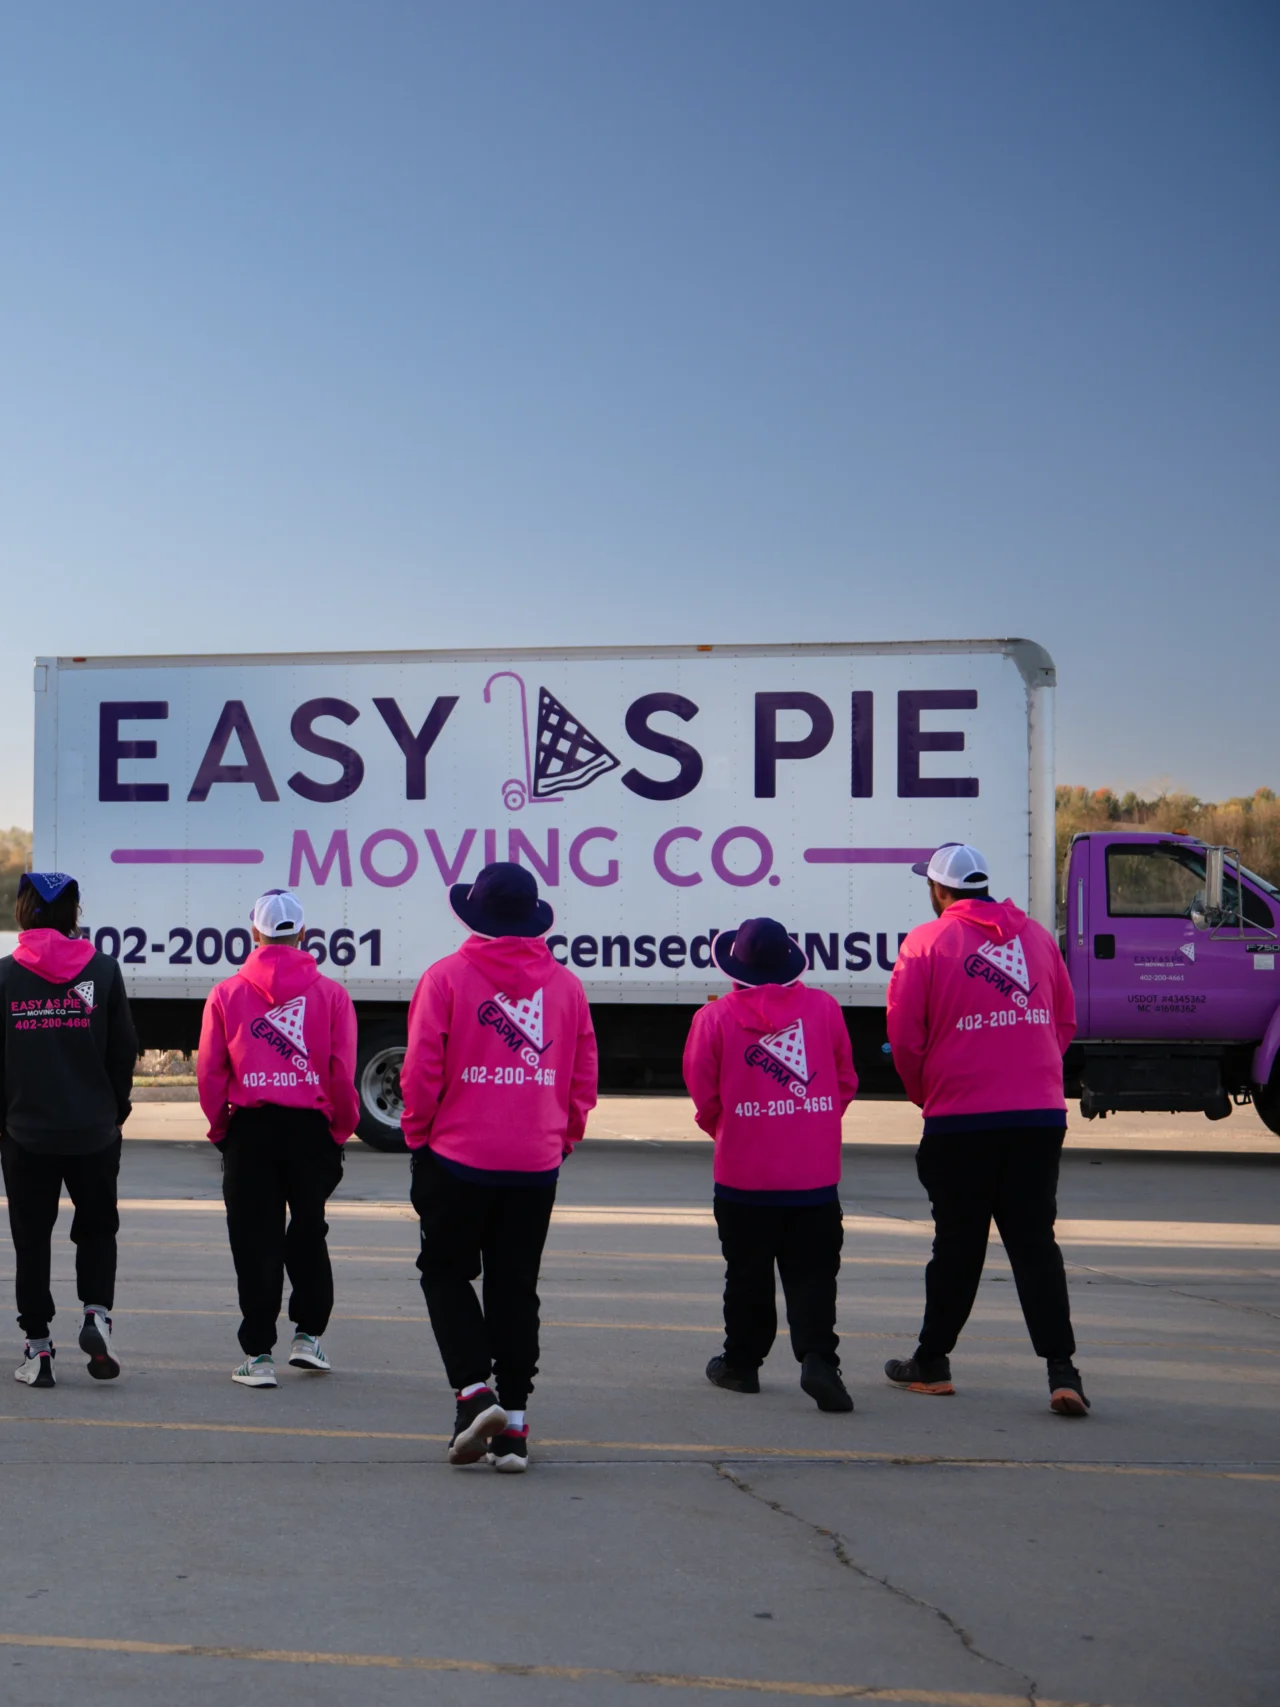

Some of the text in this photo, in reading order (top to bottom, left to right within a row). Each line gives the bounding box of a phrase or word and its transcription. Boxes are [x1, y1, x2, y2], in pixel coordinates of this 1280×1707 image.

[98, 695, 460, 803] EASY
[753, 689, 980, 799] PIE
[288, 826, 781, 887] MOVING CO.
[969, 957, 1014, 998] EAPM
[11, 998, 82, 1012] EASY AS PIE
[1127, 994, 1158, 1003] USDOT
[1137, 1004, 1151, 1013] MC
[481, 1005, 525, 1053] EAPM
[956, 1008, 1051, 1032] 402-200-4661
[254, 1021, 294, 1061] EAPM
[748, 1047, 791, 1087] EAPM
[734, 1095, 834, 1117] 402-200-4661
